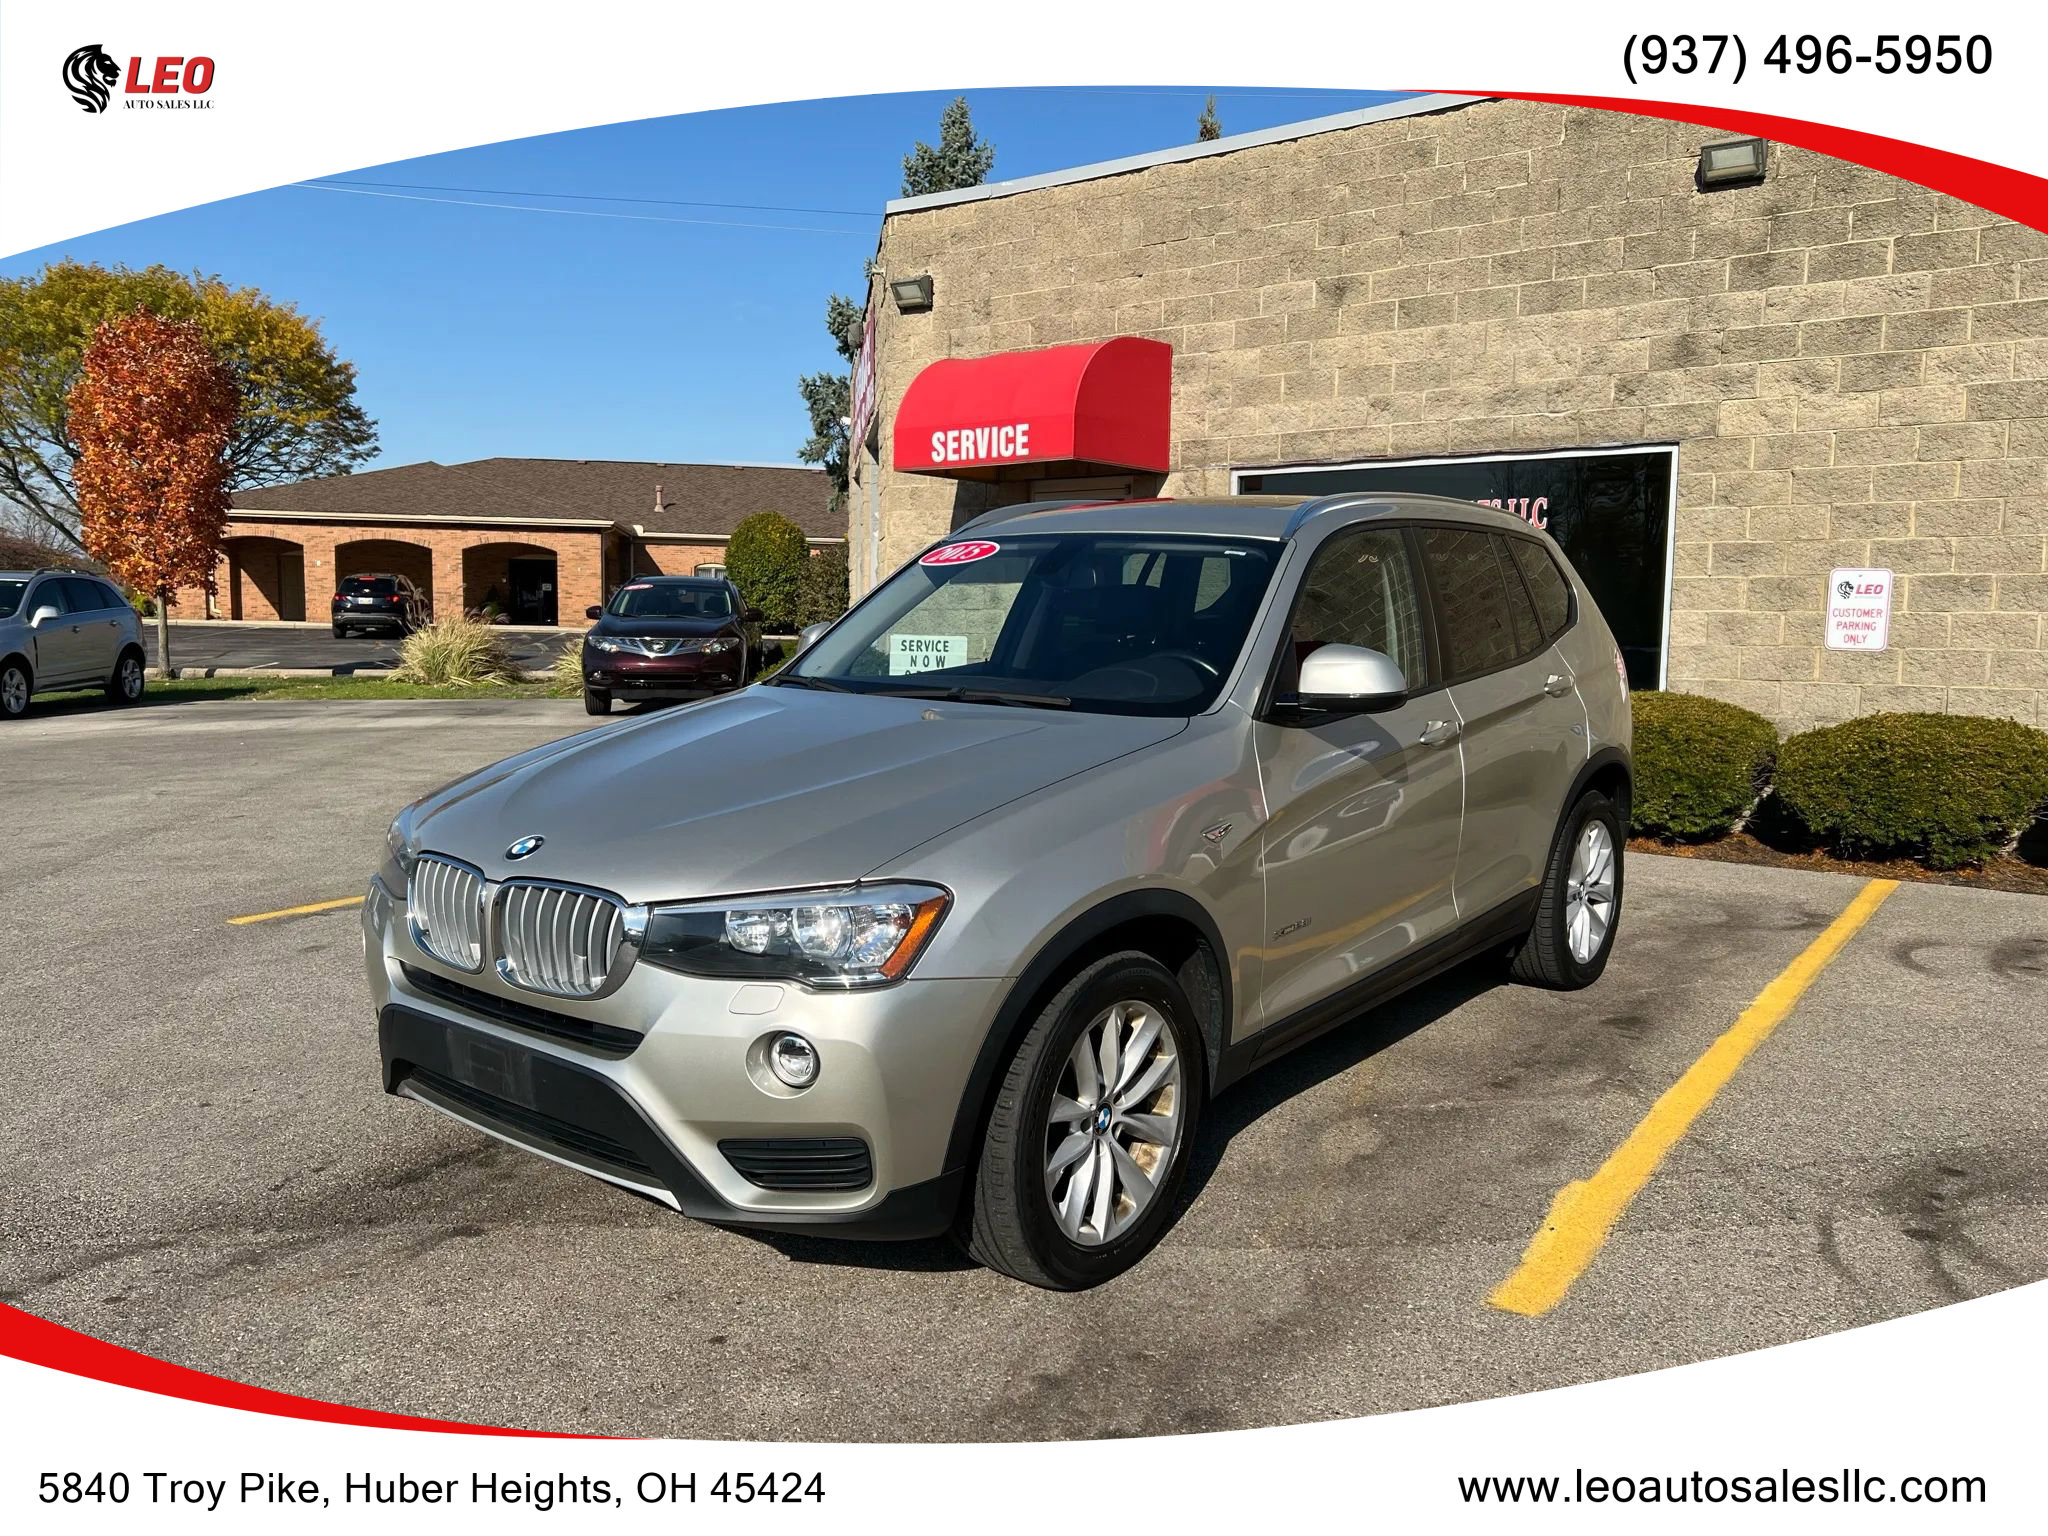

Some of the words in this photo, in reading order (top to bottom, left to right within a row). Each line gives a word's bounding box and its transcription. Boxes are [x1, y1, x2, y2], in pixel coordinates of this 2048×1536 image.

[931, 423, 1030, 463] SERVICE
[925, 544, 991, 562] 2015
[1855, 584, 1884, 595] LEO
[1832, 608, 1883, 618] CUSTOMER
[1836, 621, 1877, 631] PARKING
[1843, 634, 1868, 644] ONLY
[901, 639, 950, 652] SERVICE
[910, 655, 946, 668] NOW
